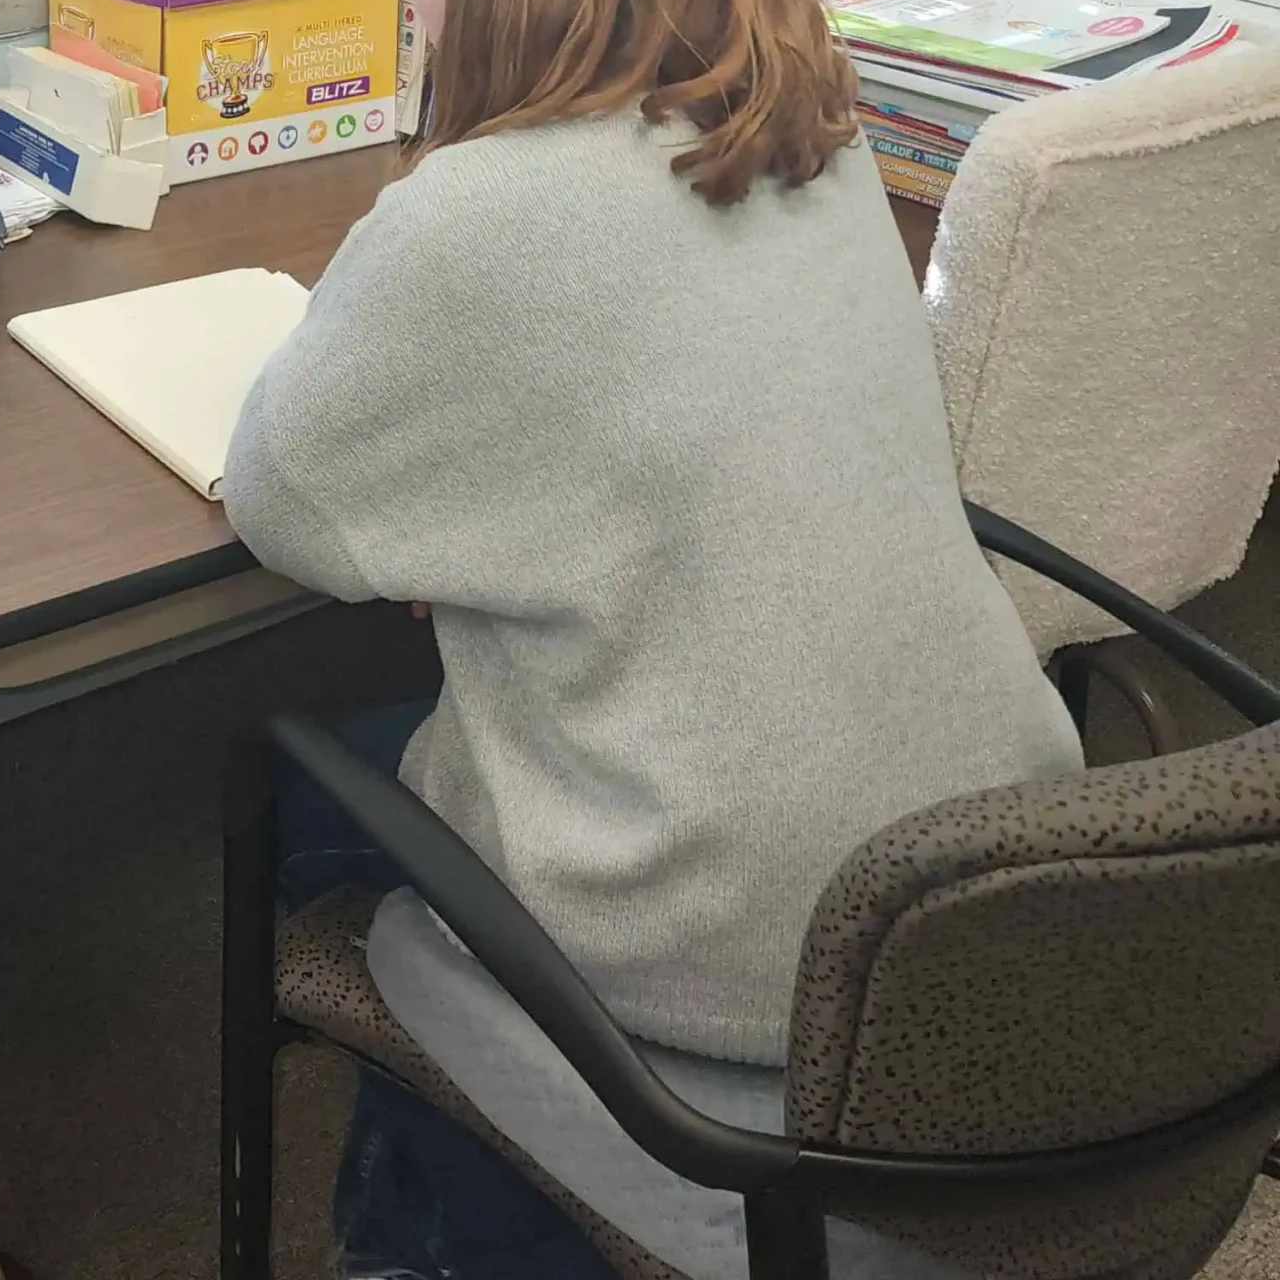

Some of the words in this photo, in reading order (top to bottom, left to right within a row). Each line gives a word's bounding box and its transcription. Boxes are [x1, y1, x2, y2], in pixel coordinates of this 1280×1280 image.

[292, 25, 365, 50] LANGUAGE
[282, 41, 375, 70] INTERVENTION
[288, 59, 368, 84] CURRICULUM
[196, 72, 275, 101] CHAMPS
[311, 79, 367, 102] BLITZ
[877, 140, 914, 160] GRADE
[914, 151, 922, 162] 2
[923, 153, 946, 168] TEST
